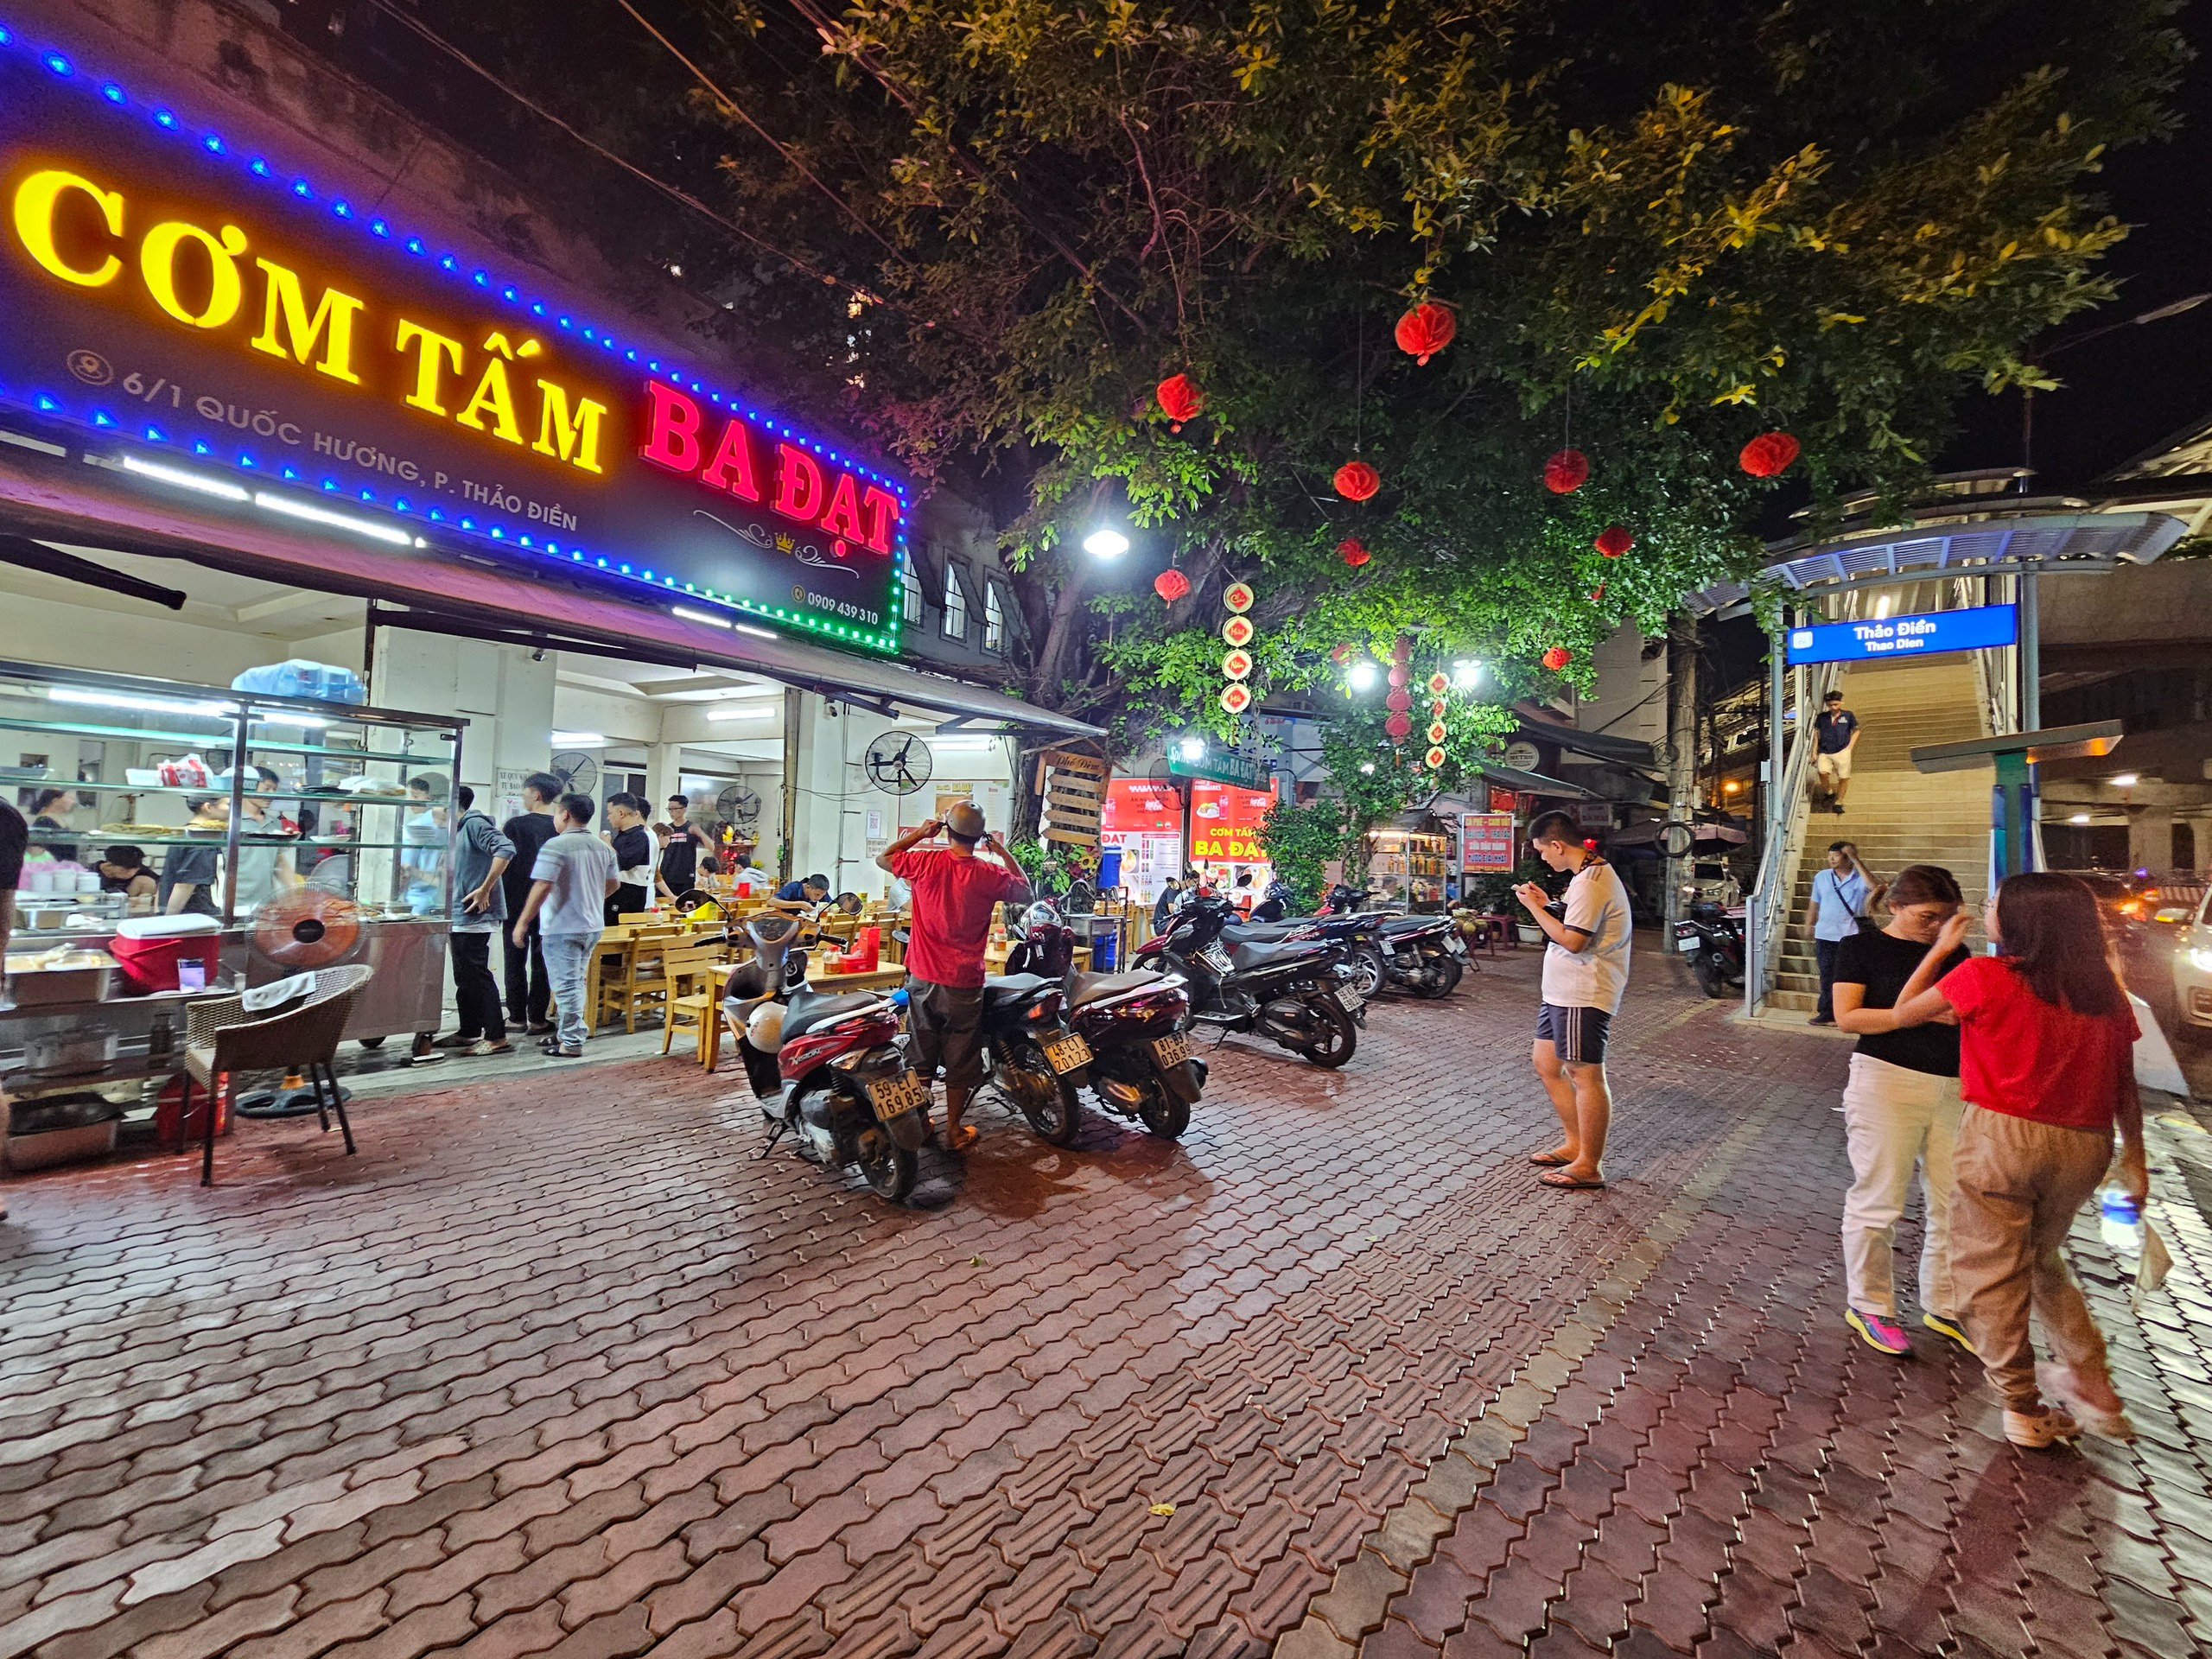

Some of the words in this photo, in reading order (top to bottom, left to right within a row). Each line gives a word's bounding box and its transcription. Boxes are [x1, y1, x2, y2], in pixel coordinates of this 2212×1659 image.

[13, 169, 365, 385] CƠM
[396, 319, 608, 474] TẤM
[639, 379, 760, 502] BA
[771, 443, 899, 558] ĐẠT
[123, 372, 181, 408] 6/1
[196, 396, 302, 445] QUỐC
[462, 480, 522, 513] THẢO
[527, 502, 577, 531] ĐIỀN
[808, 592, 836, 612] 0909
[837, 602, 858, 619] 439
[859, 608, 879, 626] 310
[1853, 624, 1894, 640] Thảo
[1866, 640, 1894, 652] Thao
[1897, 639, 1924, 650] Dien
[1210, 827, 1233, 836] CƠM
[1194, 840, 1224, 856] BA
[1228, 841, 1268, 861] ĐẠ
[1052, 1039, 1080, 1058] 48-C1
[1054, 1048, 1090, 1072] 201.23
[878, 1088, 922, 1117] 169.85
